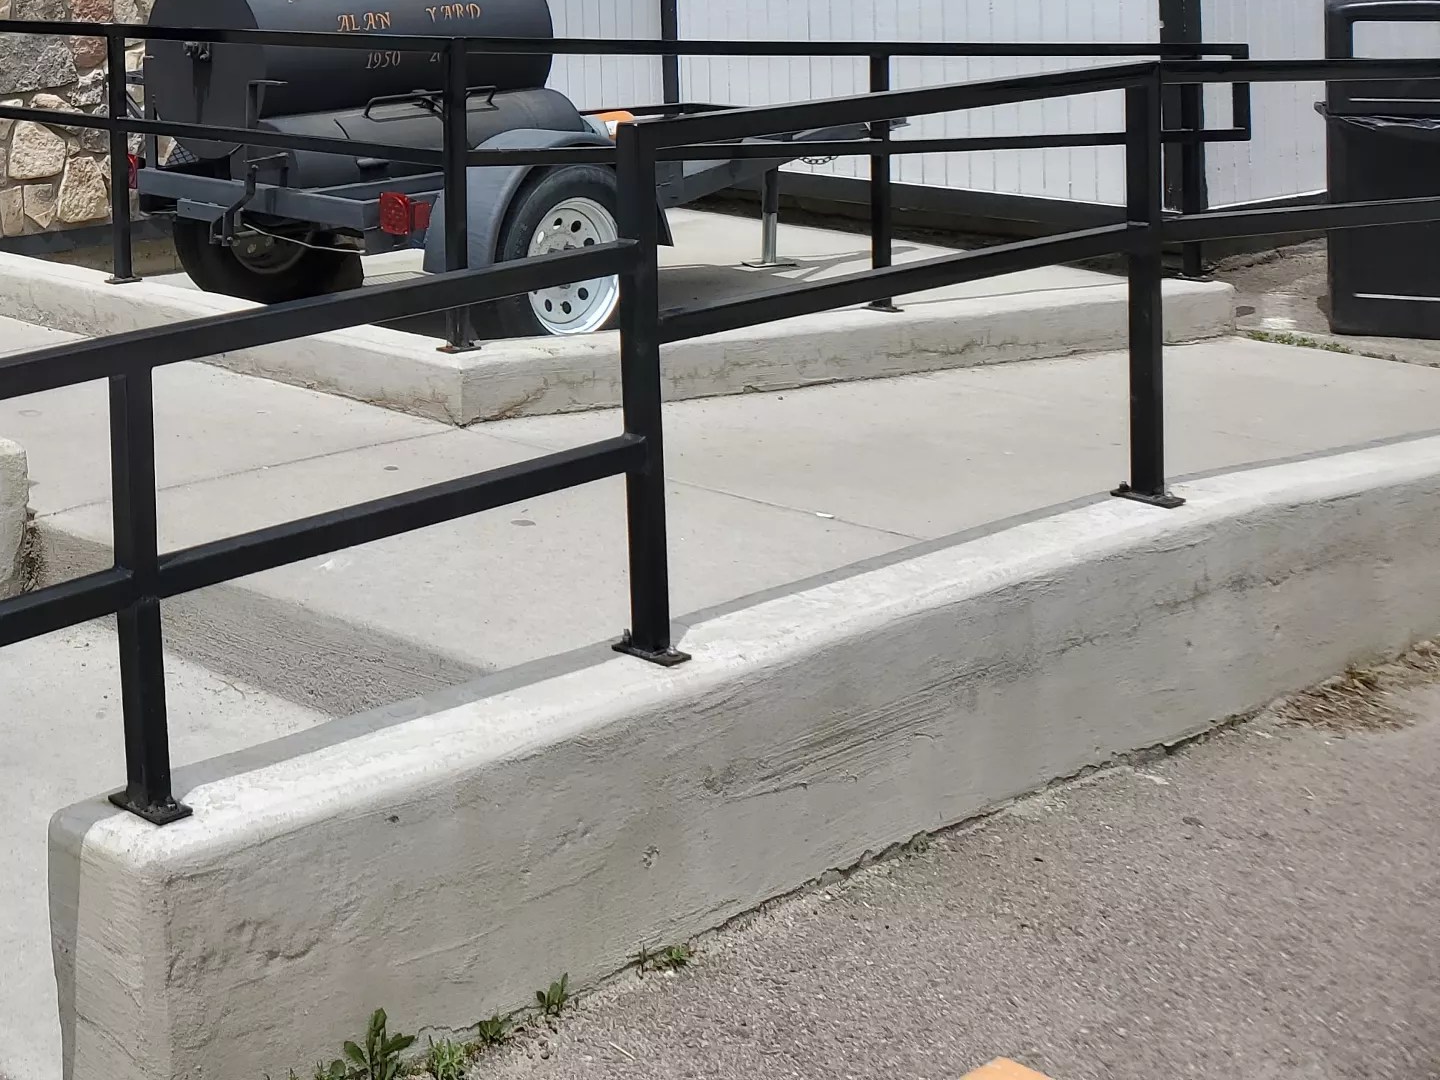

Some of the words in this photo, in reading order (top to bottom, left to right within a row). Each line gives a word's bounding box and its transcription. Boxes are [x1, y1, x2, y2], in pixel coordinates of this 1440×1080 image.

[337, 11, 392, 32] ALAN
[425, 3, 481, 24] YARD
[365, 50, 401, 69] 1950
